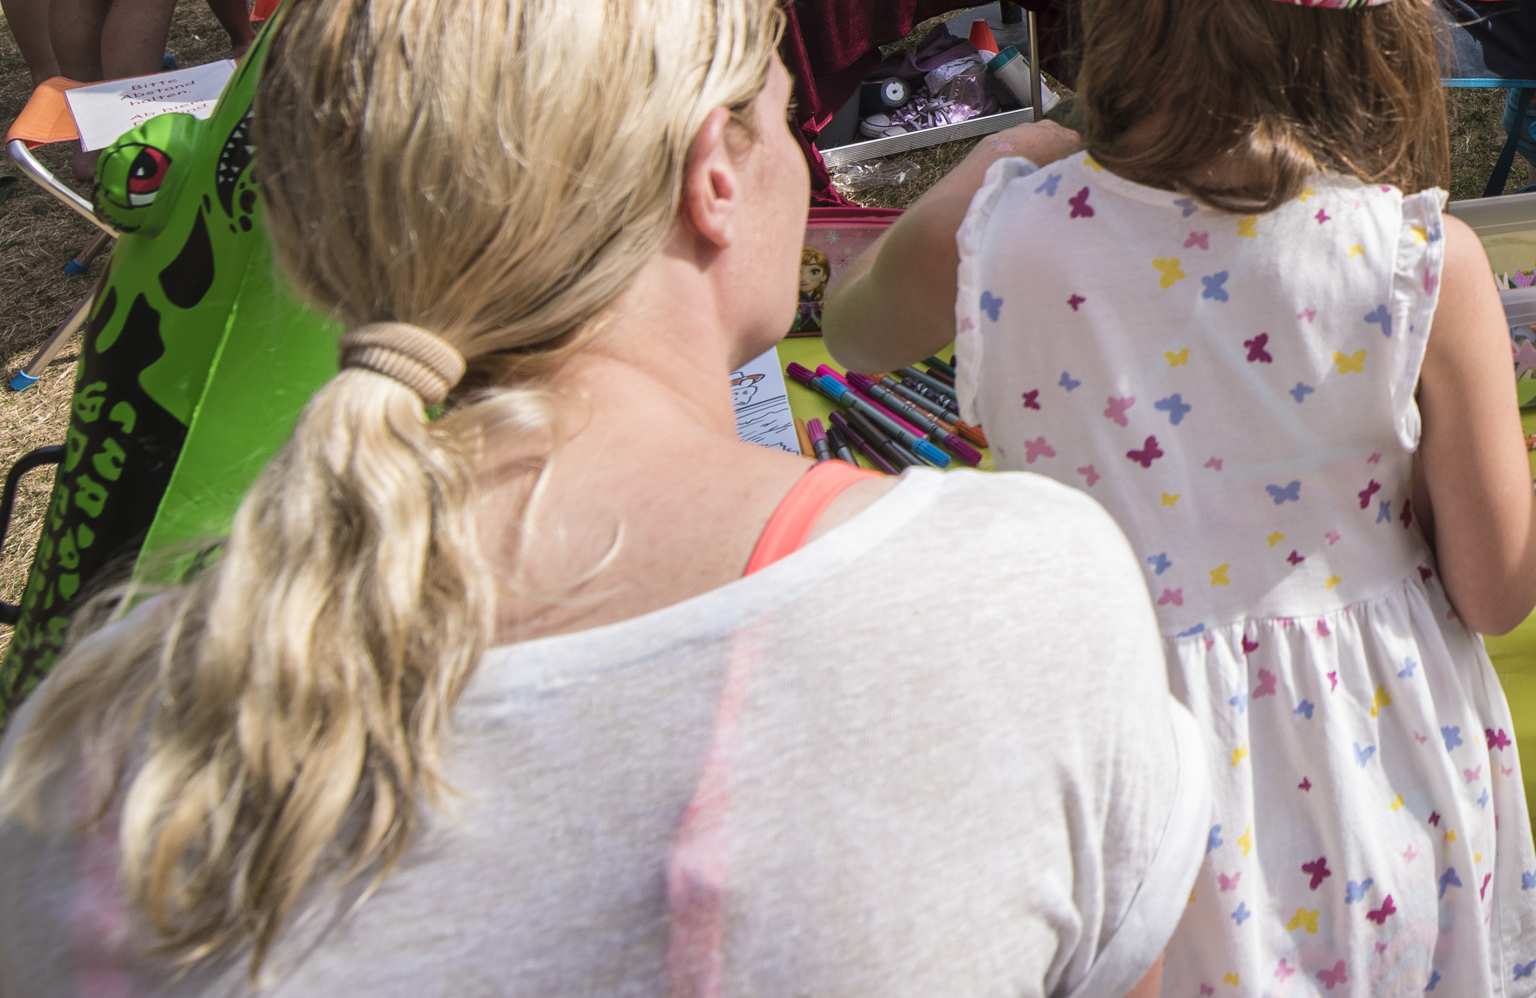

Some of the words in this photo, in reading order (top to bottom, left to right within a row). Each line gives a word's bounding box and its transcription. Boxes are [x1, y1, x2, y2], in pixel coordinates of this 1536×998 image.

[120, 80, 196, 101] Abstand
[131, 79, 178, 91] Bitte
[130, 90, 192, 106] halten.
[130, 109, 155, 120] Ab
